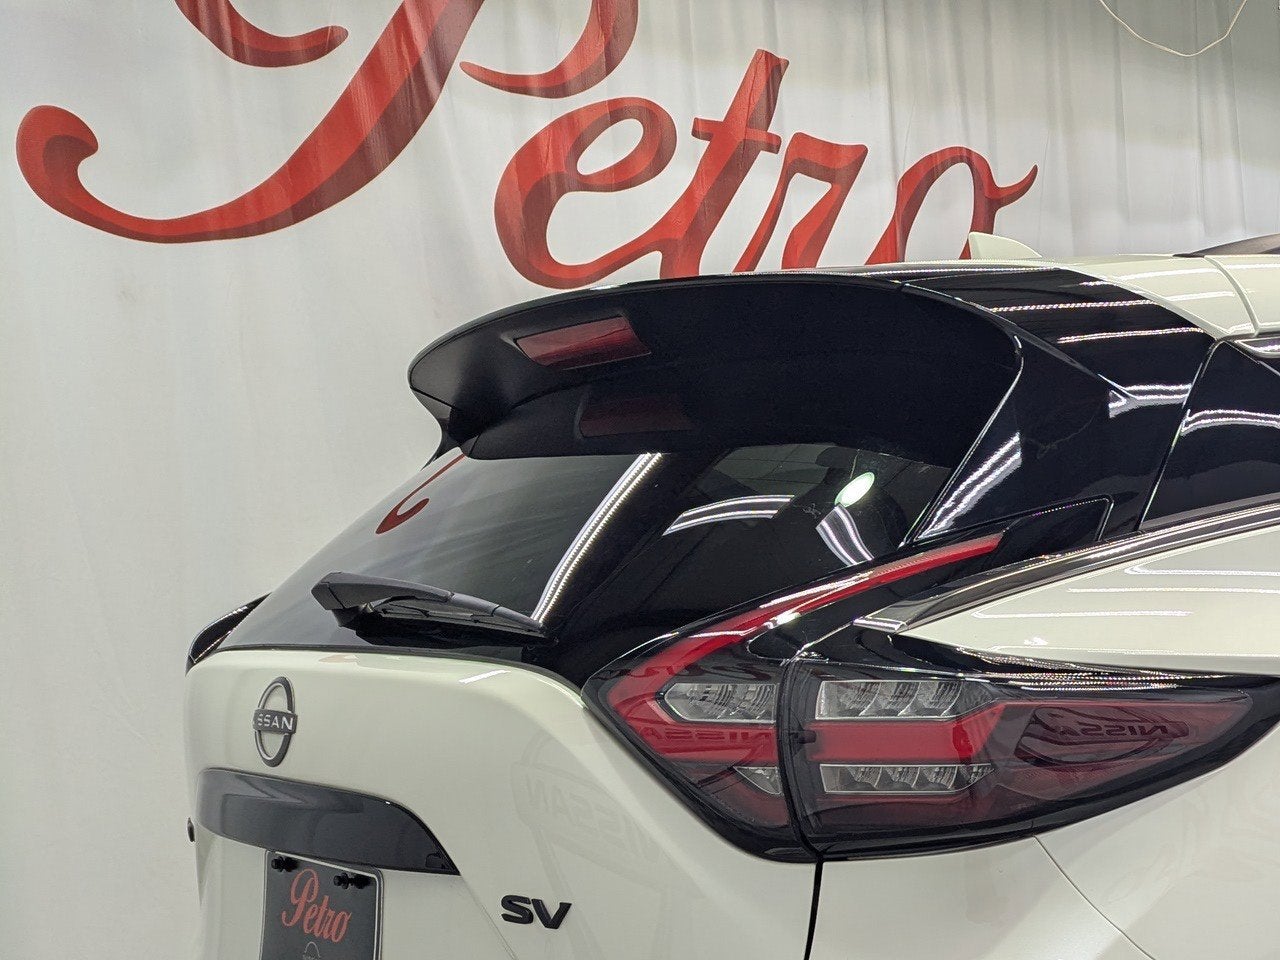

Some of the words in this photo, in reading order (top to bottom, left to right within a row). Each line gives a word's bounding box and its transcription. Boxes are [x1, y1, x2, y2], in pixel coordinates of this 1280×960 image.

[257, 713, 294, 731] SSAN
[281, 868, 352, 943] Petro
[501, 894, 572, 930] SV
